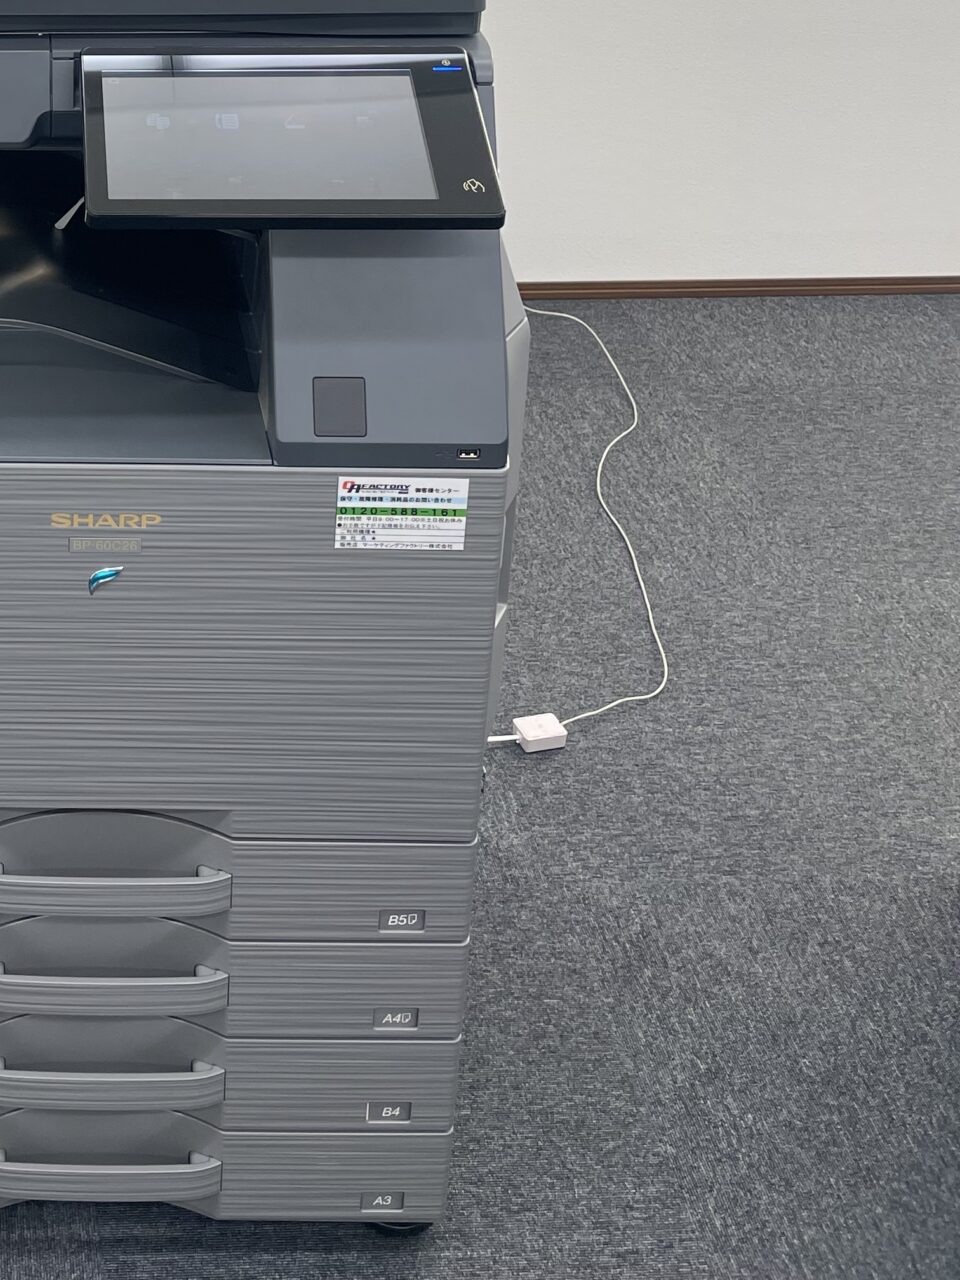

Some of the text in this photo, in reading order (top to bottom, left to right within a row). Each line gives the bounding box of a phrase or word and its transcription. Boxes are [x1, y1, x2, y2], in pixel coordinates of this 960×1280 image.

[50, 512, 162, 529] SHARP
[387, 914, 407, 925] B5
[382, 1013, 401, 1023] A4
[382, 1107, 401, 1117] B4
[373, 1195, 392, 1205] A3
